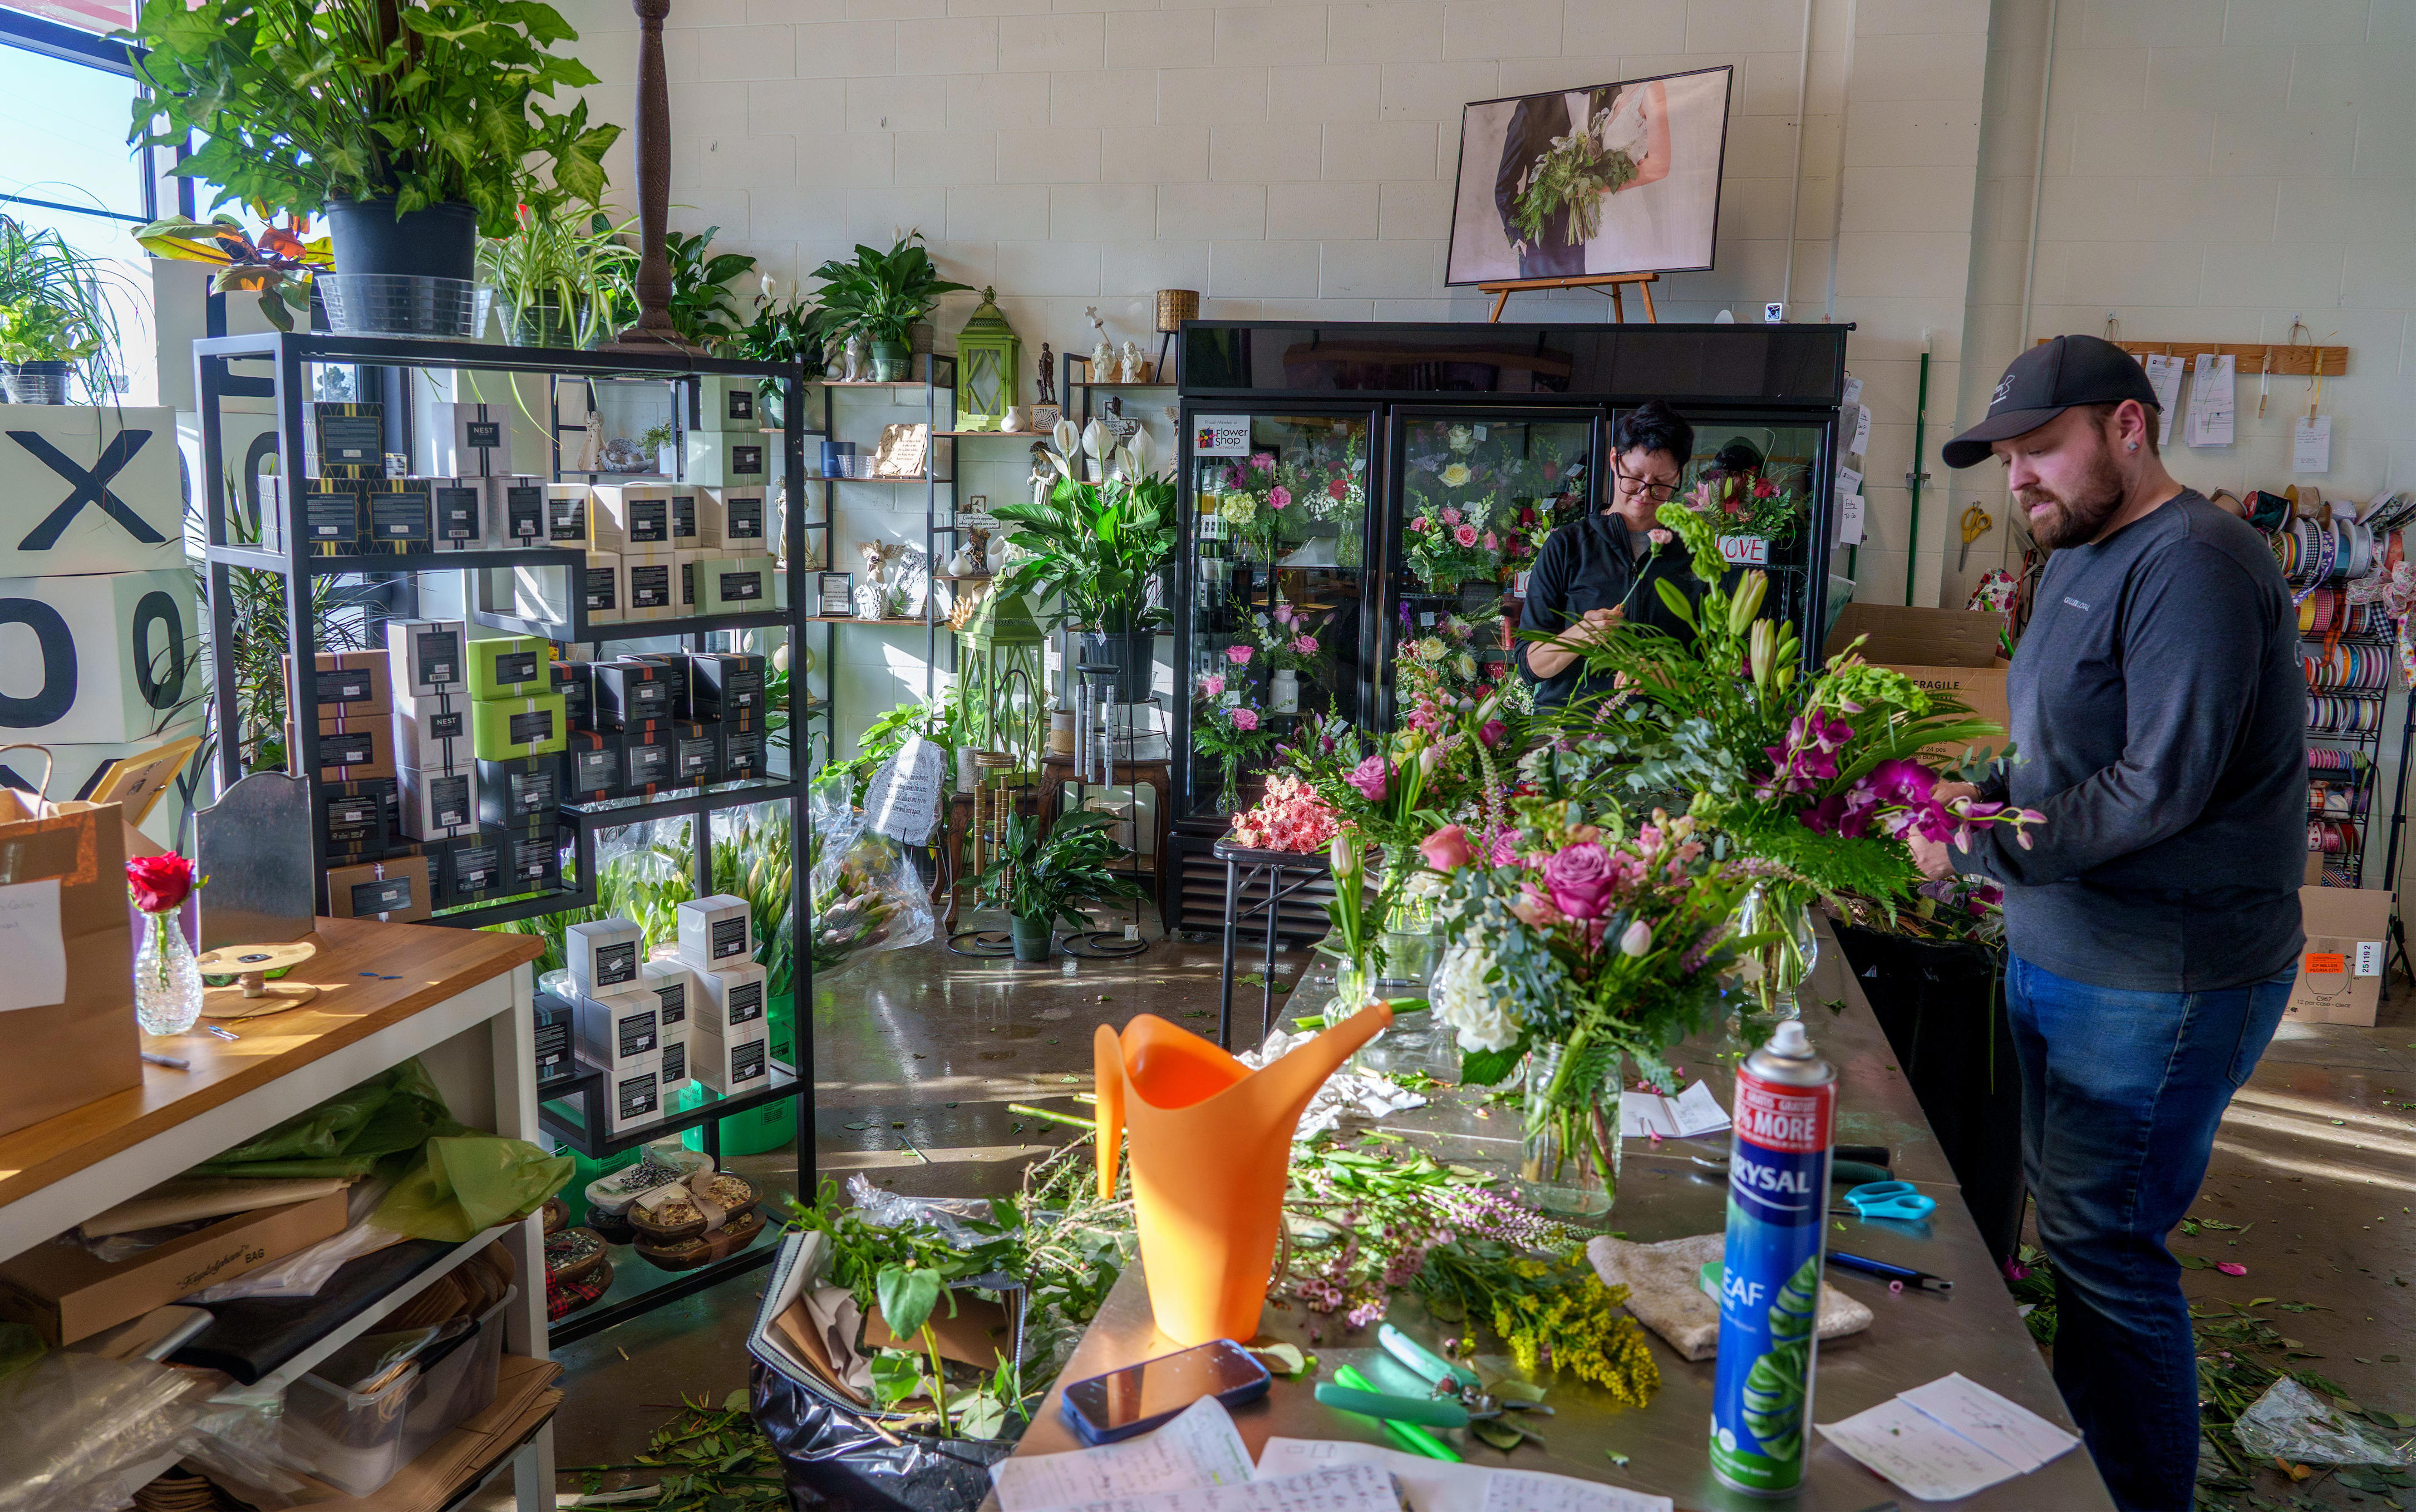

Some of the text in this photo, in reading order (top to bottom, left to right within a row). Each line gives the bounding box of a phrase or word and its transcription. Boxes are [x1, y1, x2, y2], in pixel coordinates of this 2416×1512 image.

[1216, 427, 1248, 437] Flower
[1215, 436, 1241, 446] Shop
[5, 430, 166, 550] X
[1913, 680, 1960, 689] FRAGILE
[436, 717, 456, 726] NEST
[1754, 1110, 1816, 1141] MORE
[1731, 1150, 1810, 1194] RYSAL
[244, 1248, 264, 1264] BAG
[1723, 1265, 1765, 1307] EAF
